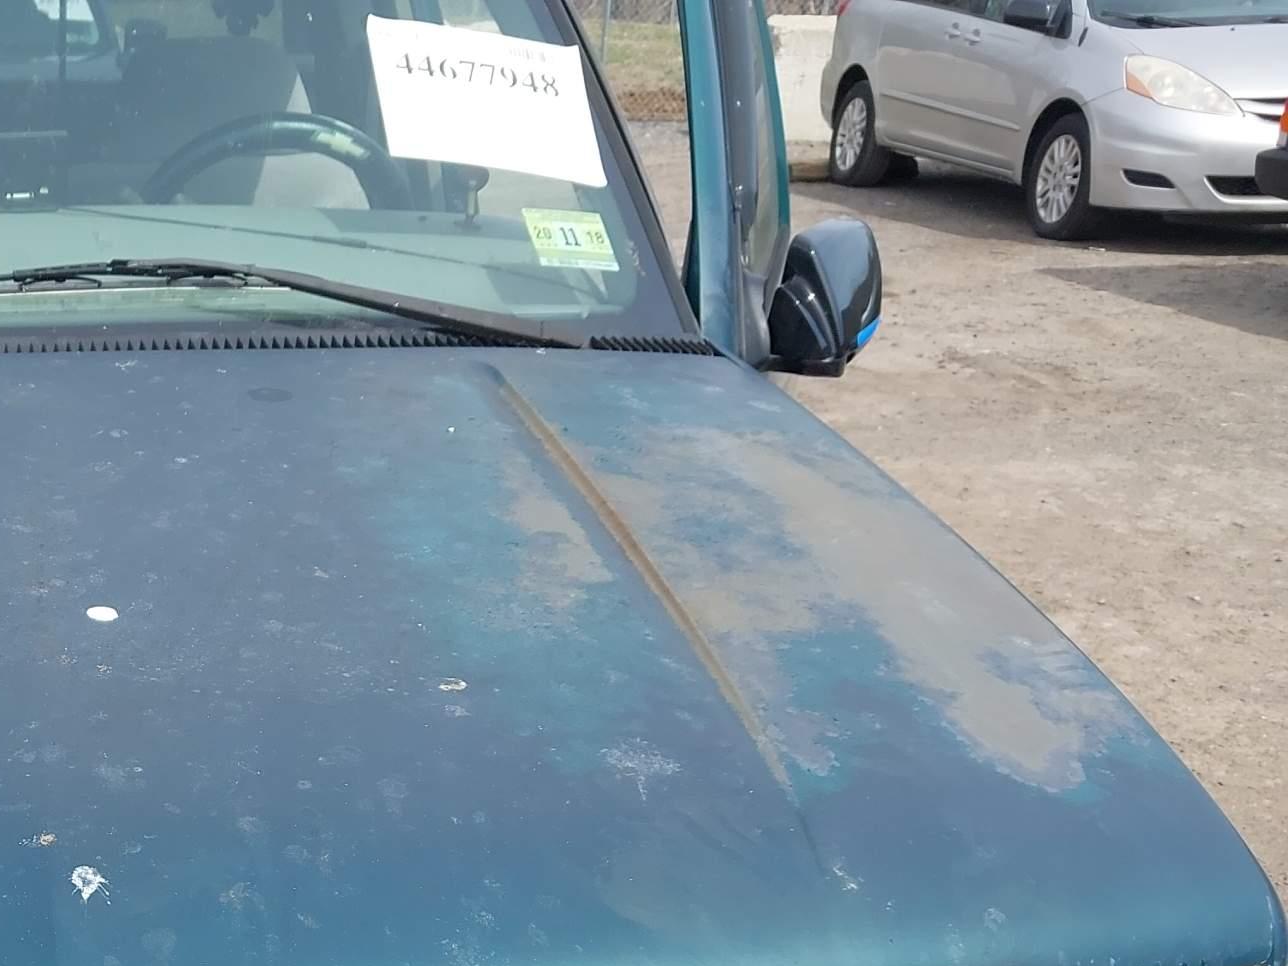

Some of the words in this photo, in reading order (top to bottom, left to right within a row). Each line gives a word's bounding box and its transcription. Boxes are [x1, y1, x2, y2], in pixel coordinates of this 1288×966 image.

[395, 52, 560, 97] 44677948
[533, 225, 552, 240] 20
[559, 226, 582, 247] 11
